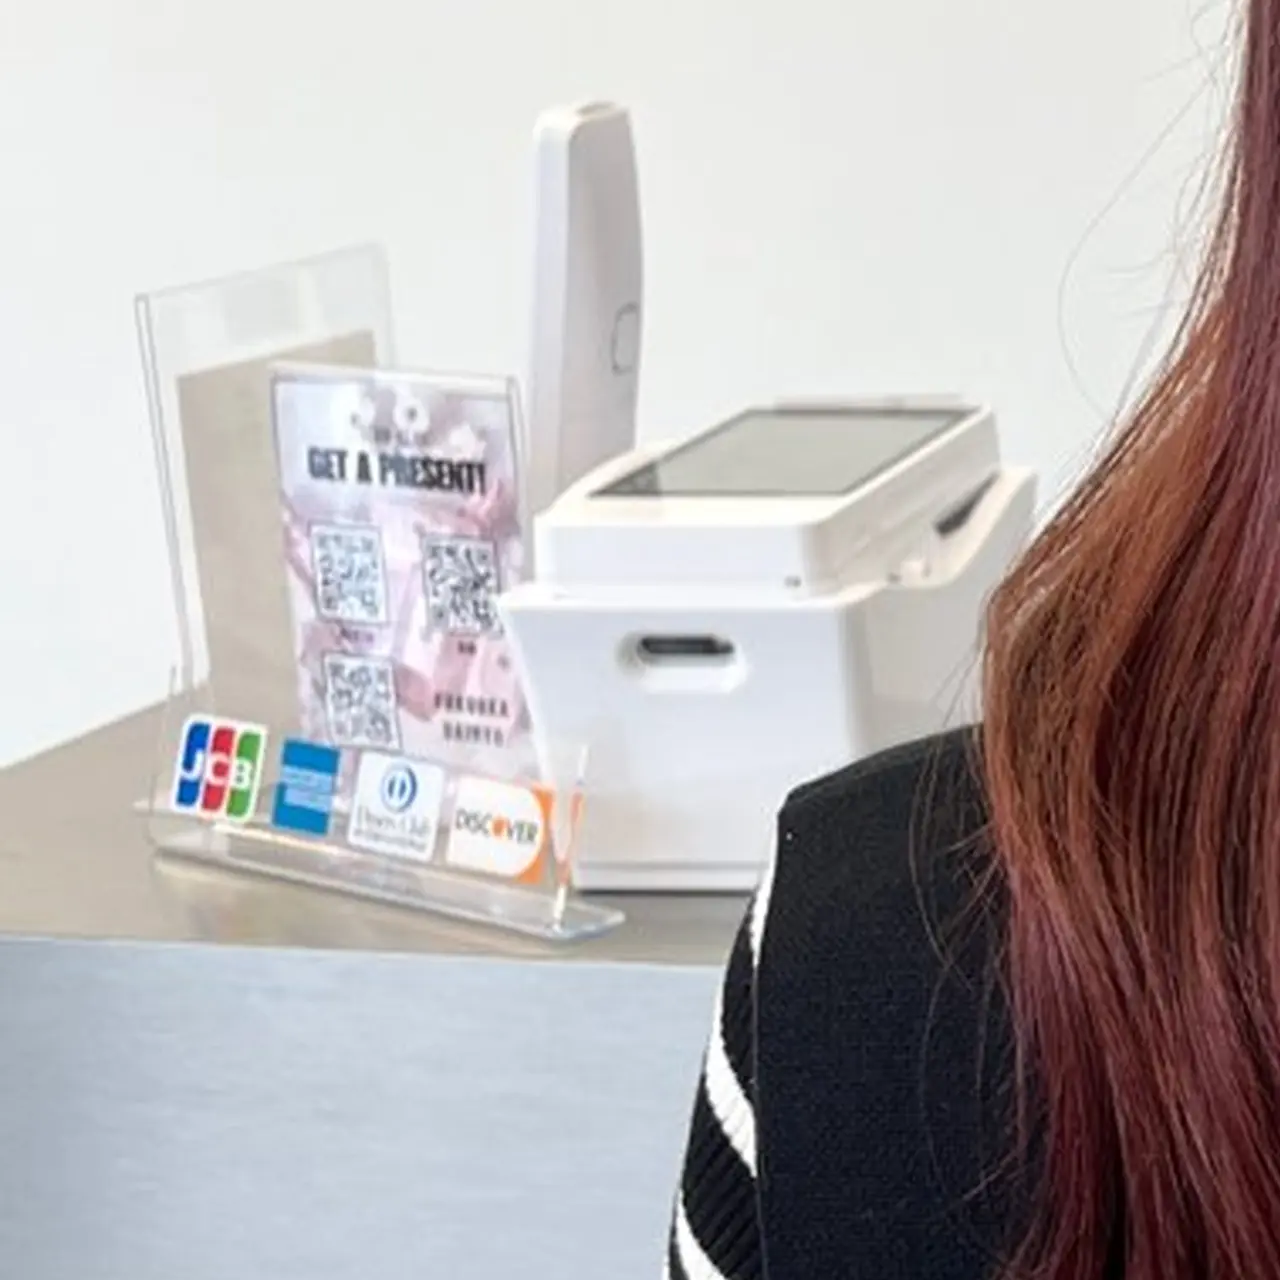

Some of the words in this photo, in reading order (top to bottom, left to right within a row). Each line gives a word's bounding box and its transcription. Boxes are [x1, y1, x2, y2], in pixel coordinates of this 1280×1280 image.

[307, 446, 347, 481] GET
[355, 449, 373, 485] A
[378, 451, 488, 495] PRESENT!
[455, 808, 539, 845] DISCOVER
